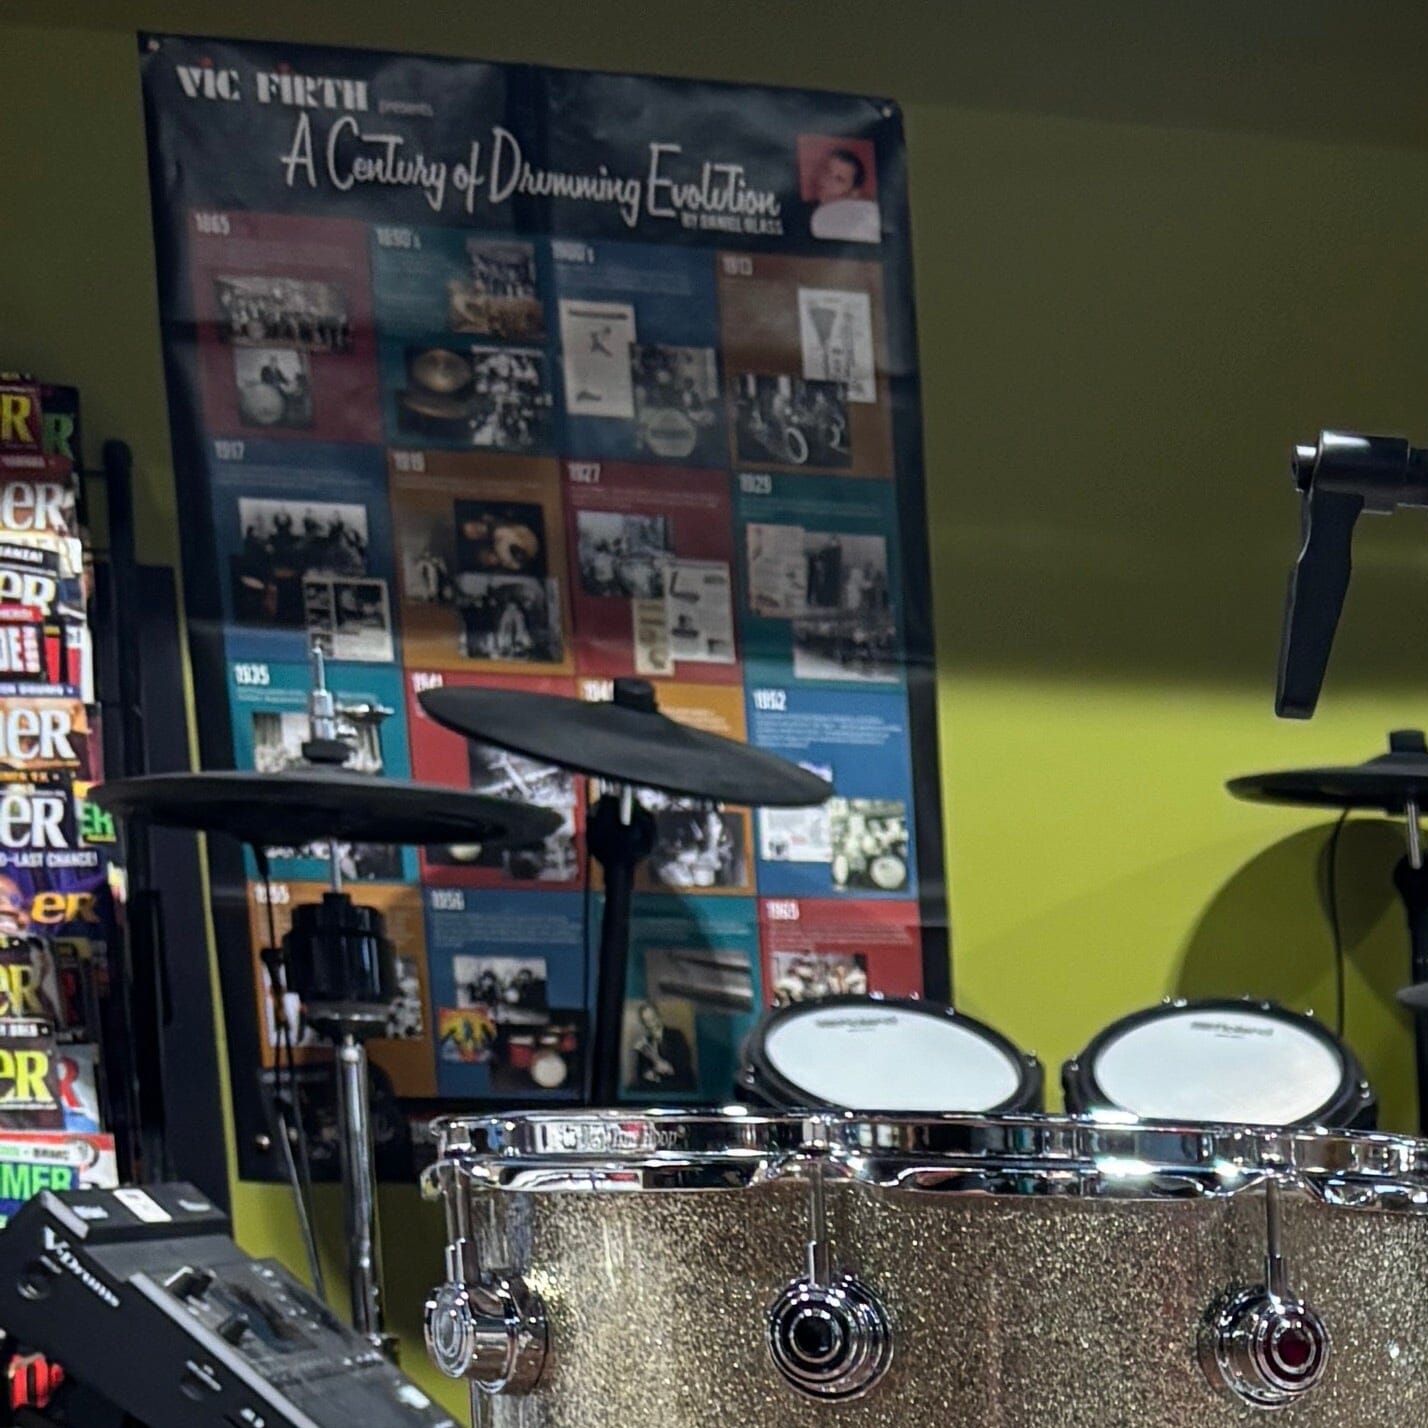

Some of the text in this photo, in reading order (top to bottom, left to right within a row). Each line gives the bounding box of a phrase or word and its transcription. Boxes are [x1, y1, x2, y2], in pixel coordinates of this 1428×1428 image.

[176, 58, 240, 101] VIC
[256, 63, 369, 112] FIRTH
[280, 112, 782, 228] A Century of Drumming Evolution
[44, 1225, 119, 1307] V-Drums
